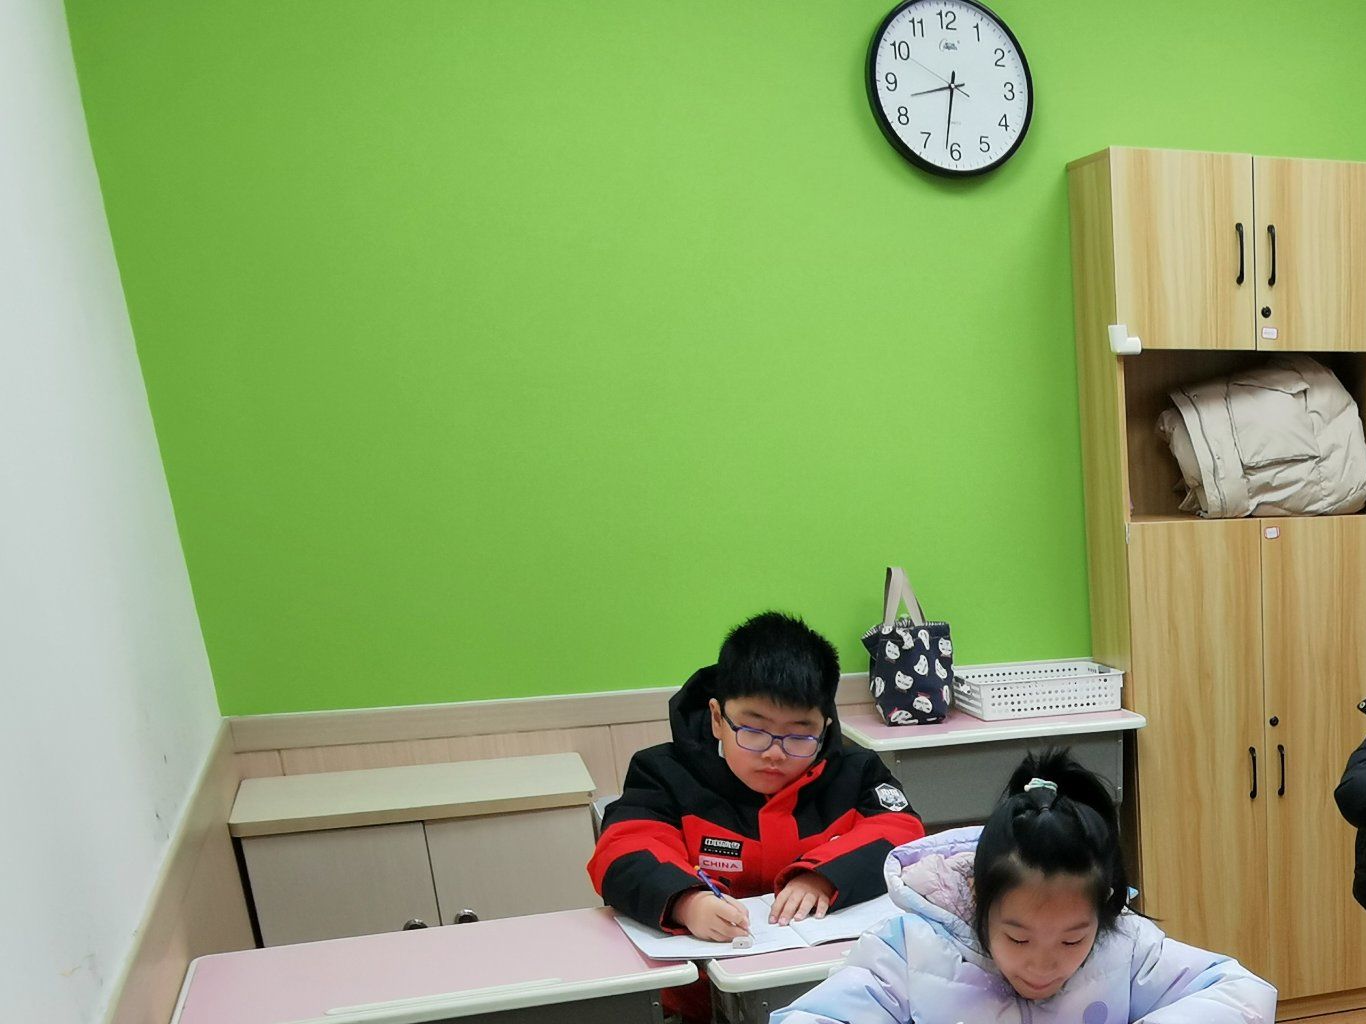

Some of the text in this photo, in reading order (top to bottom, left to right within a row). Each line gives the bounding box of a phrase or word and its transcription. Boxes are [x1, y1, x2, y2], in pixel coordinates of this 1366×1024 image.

[909, 17, 925, 38] 11
[936, 10, 957, 31] 12
[973, 23, 980, 42] 1
[890, 41, 910, 61] 10
[994, 48, 1006, 67] 2
[885, 72, 898, 91] 9
[1003, 82, 1015, 100] 3
[897, 106, 910, 125] 8
[998, 113, 1010, 131] 4
[920, 131, 932, 149] 7
[979, 136, 990, 152] 5
[950, 143, 962, 161] 6
[702, 859, 739, 869] CHINA
